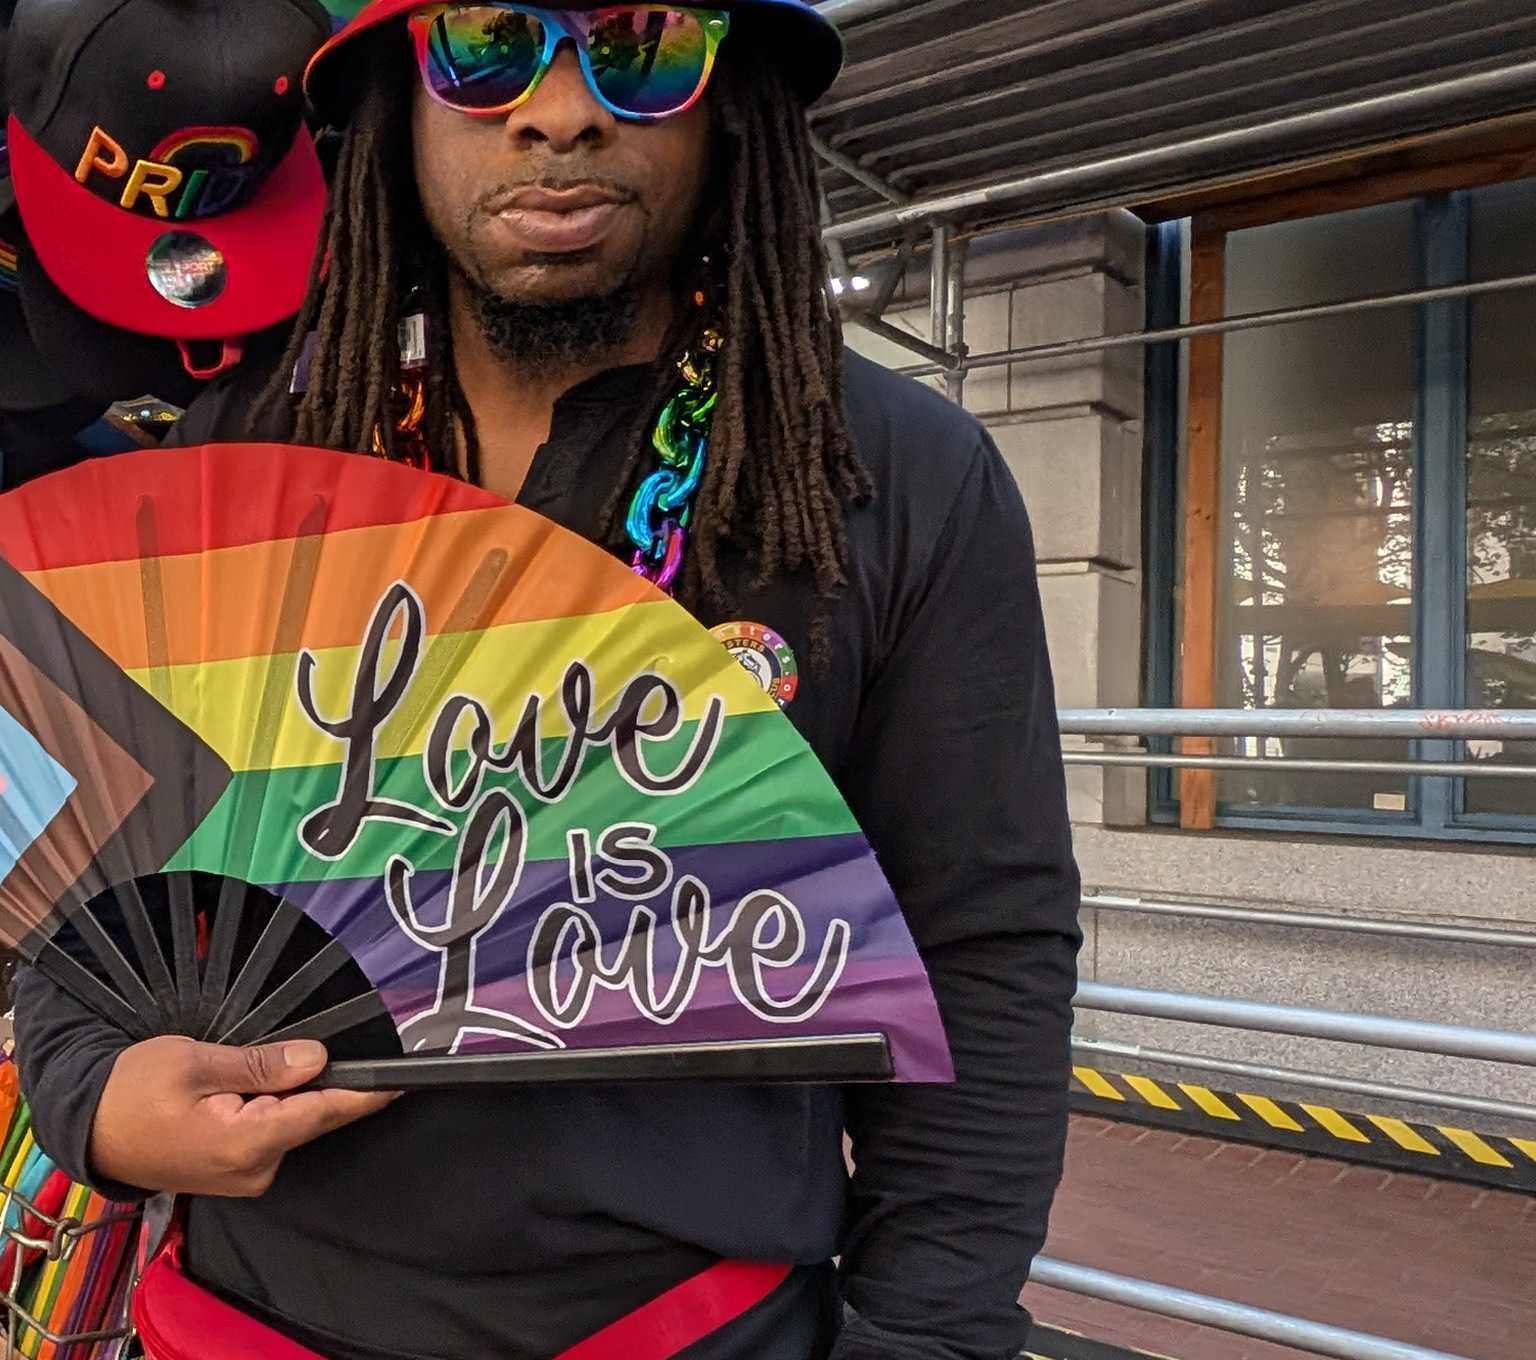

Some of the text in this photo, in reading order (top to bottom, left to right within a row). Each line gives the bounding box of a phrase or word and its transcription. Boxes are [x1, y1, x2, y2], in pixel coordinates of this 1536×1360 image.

[74, 125, 252, 218] PRID
[297, 578, 723, 862] Love
[384, 786, 851, 1054] Love
